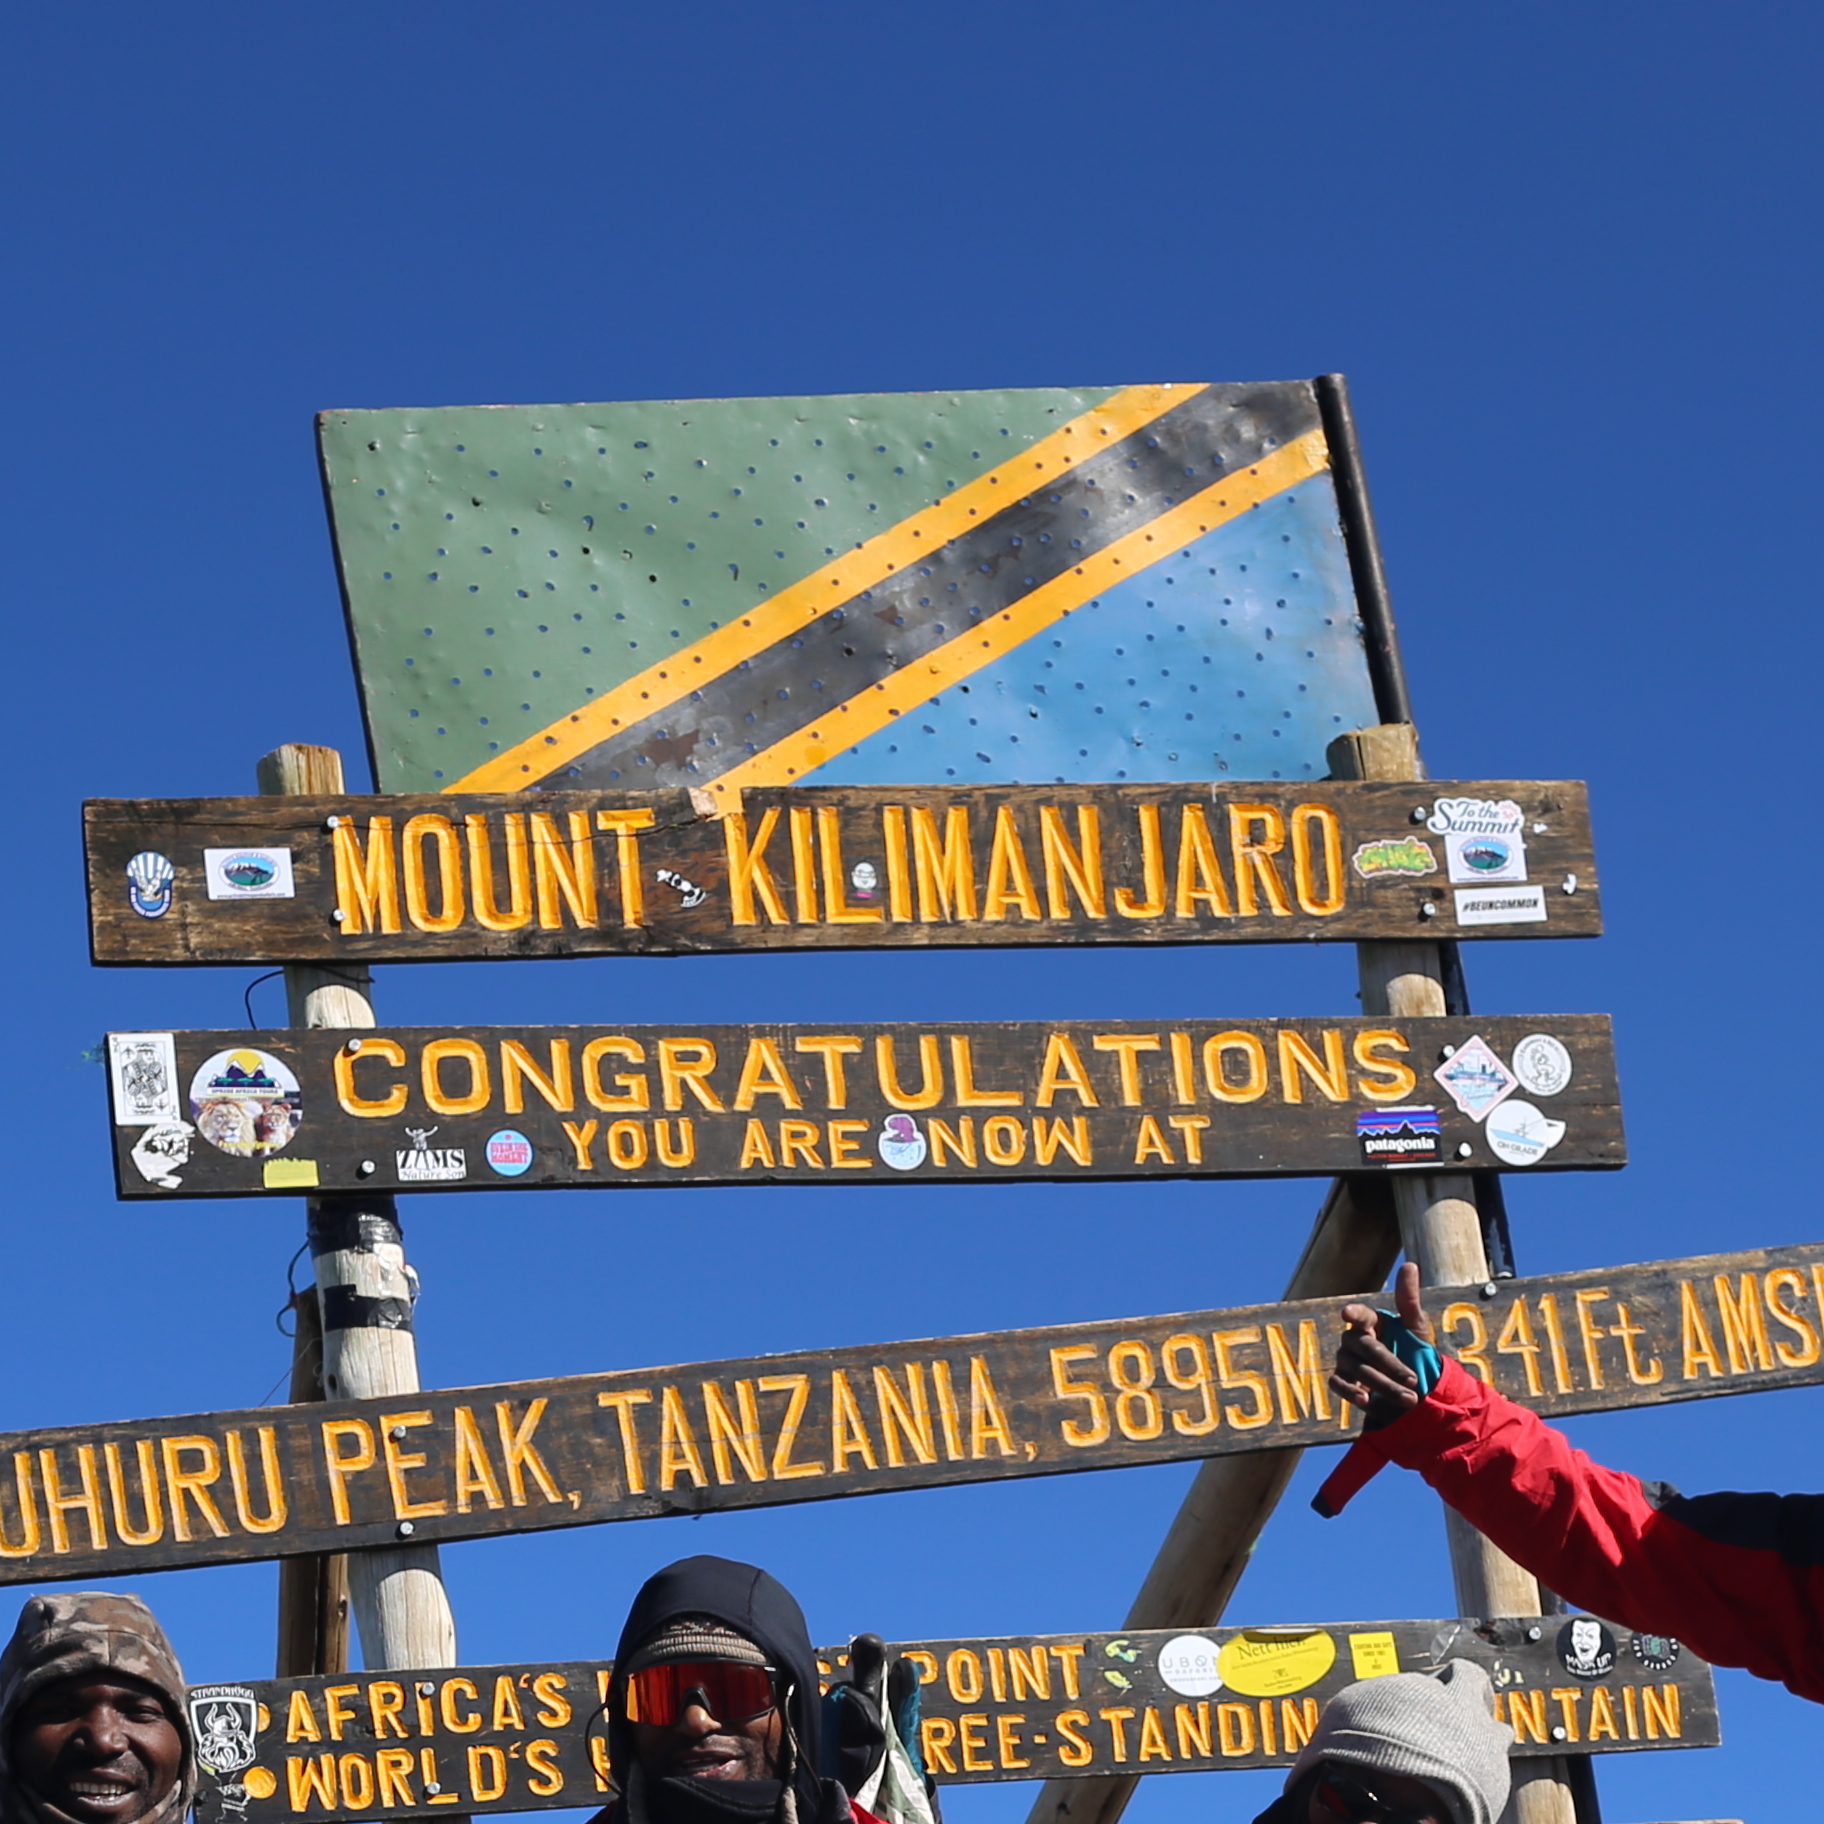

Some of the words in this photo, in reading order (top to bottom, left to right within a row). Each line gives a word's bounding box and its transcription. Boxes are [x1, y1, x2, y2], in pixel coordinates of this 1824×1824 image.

[1430, 801, 1520, 834] Summit
[1456, 801, 1474, 818] To
[1478, 803, 1500, 819] the
[330, 807, 656, 935] MOUNT
[723, 802, 1347, 927] KILIMANJARO
[1462, 898, 1540, 914] #BEUNCOMMON
[334, 1029, 1418, 1118] CONGRATULATIONS
[562, 1117, 698, 1171] YOU
[740, 1117, 874, 1169] ARE
[927, 1115, 1094, 1168] NOW
[1134, 1114, 1212, 1165] AT
[1365, 1136, 1436, 1153] patagonia
[401, 1169, 442, 1181] Nature
[322, 1397, 581, 1525] PEAK,
[597, 1354, 1038, 1492] TANZANIA,
[1236, 1642, 1272, 1661] Nett
[1597, 1652, 1612, 1668] UP
[287, 1673, 571, 1744] AFRICA'S
[920, 1697, 1319, 1774] REE-STANDIN
[287, 1738, 564, 1813] WORLD'S
